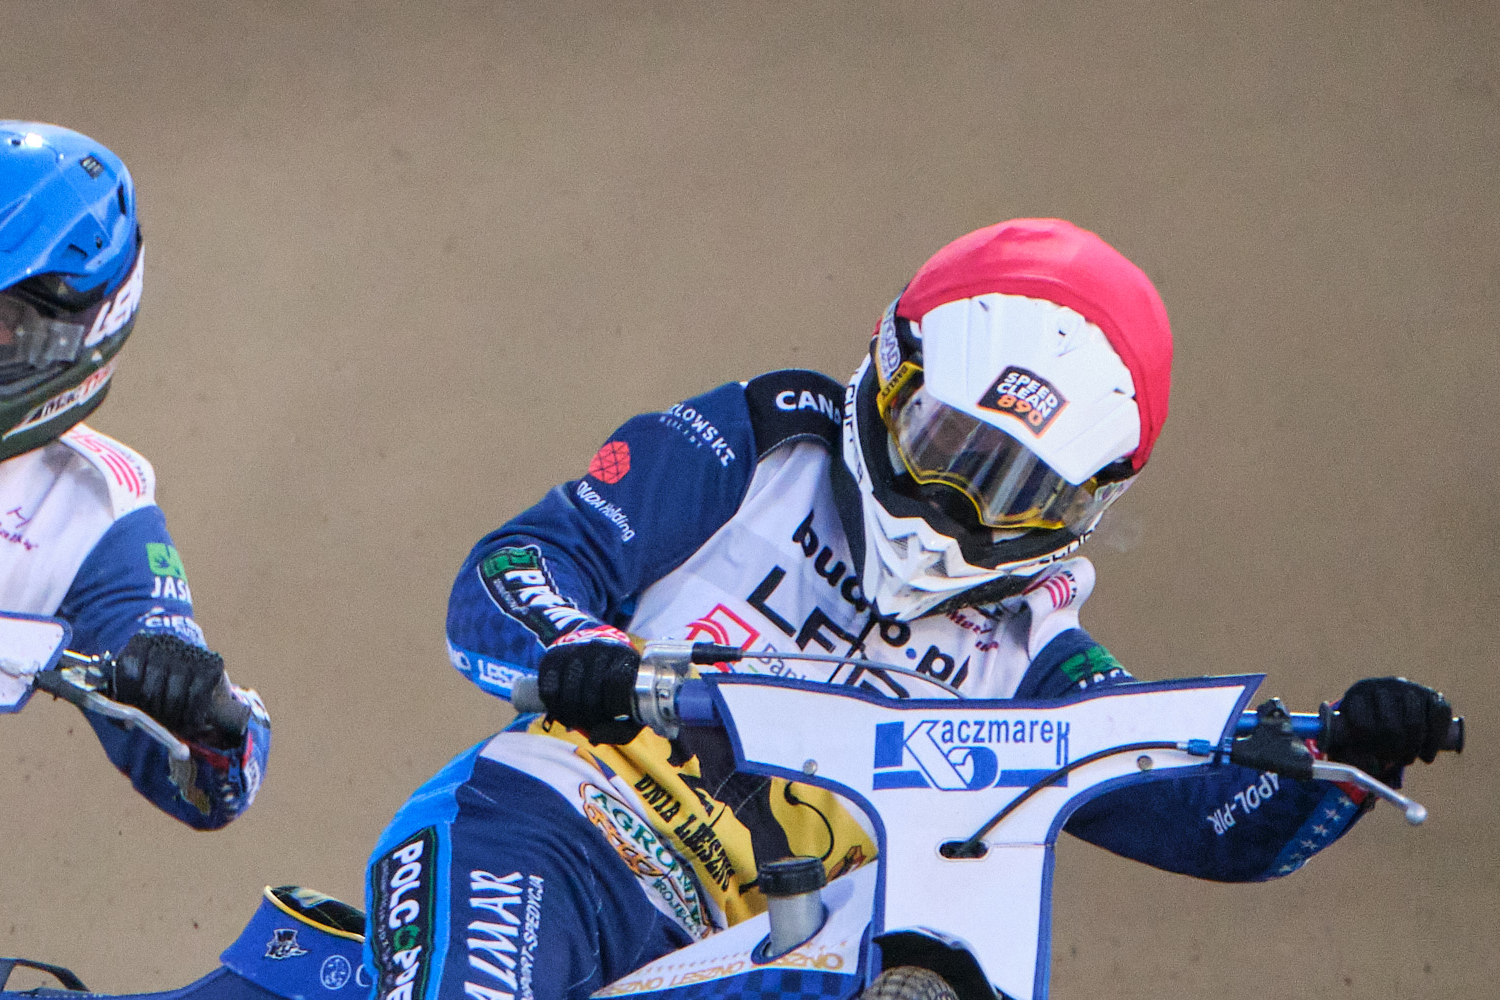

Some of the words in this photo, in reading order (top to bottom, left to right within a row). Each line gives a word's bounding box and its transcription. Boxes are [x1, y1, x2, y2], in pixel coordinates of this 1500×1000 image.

[996, 382, 1052, 418] CLEAN
[1003, 371, 1058, 409] SPEED
[997, 394, 1043, 426] 890
[904, 719, 1071, 791] Kaczmarek
[635, 774, 681, 823] UNIA
